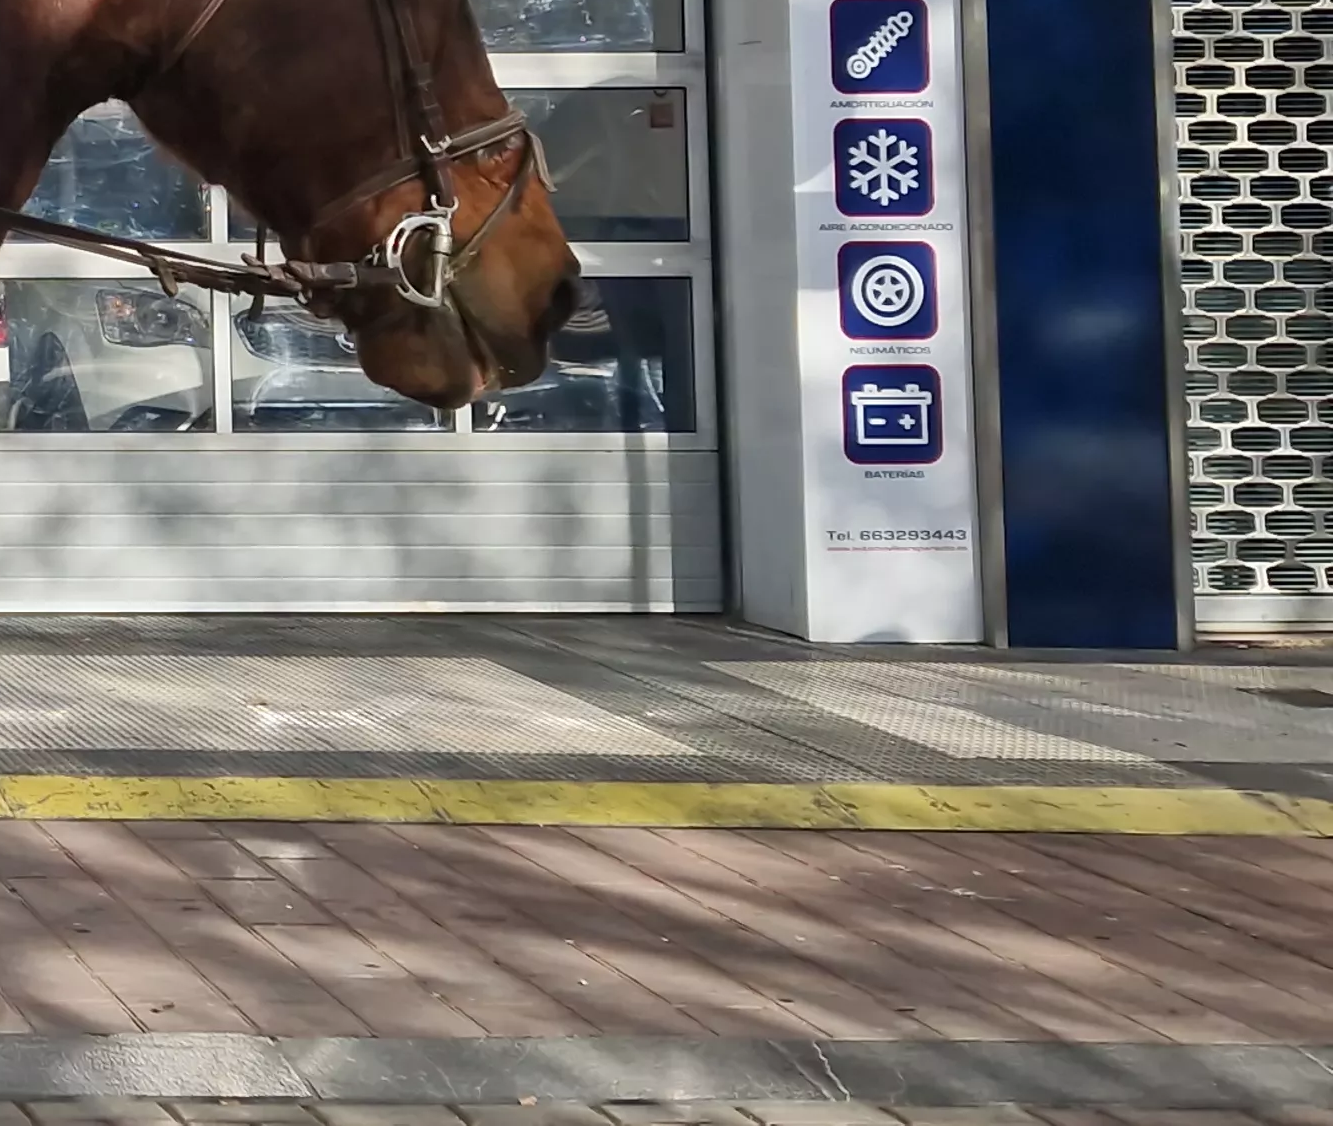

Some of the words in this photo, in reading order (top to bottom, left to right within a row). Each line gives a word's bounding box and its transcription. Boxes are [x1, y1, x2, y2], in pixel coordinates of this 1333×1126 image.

[829, 99, 934, 108] AMORTIGUACIÓN
[819, 223, 847, 231] AIRE
[849, 223, 954, 231] ACONDICIONADO
[849, 345, 932, 355] NEUMÁTICOS
[864, 469, 925, 479] BATERÍAS
[825, 529, 855, 542] Tel.
[859, 529, 967, 542] 663293443
